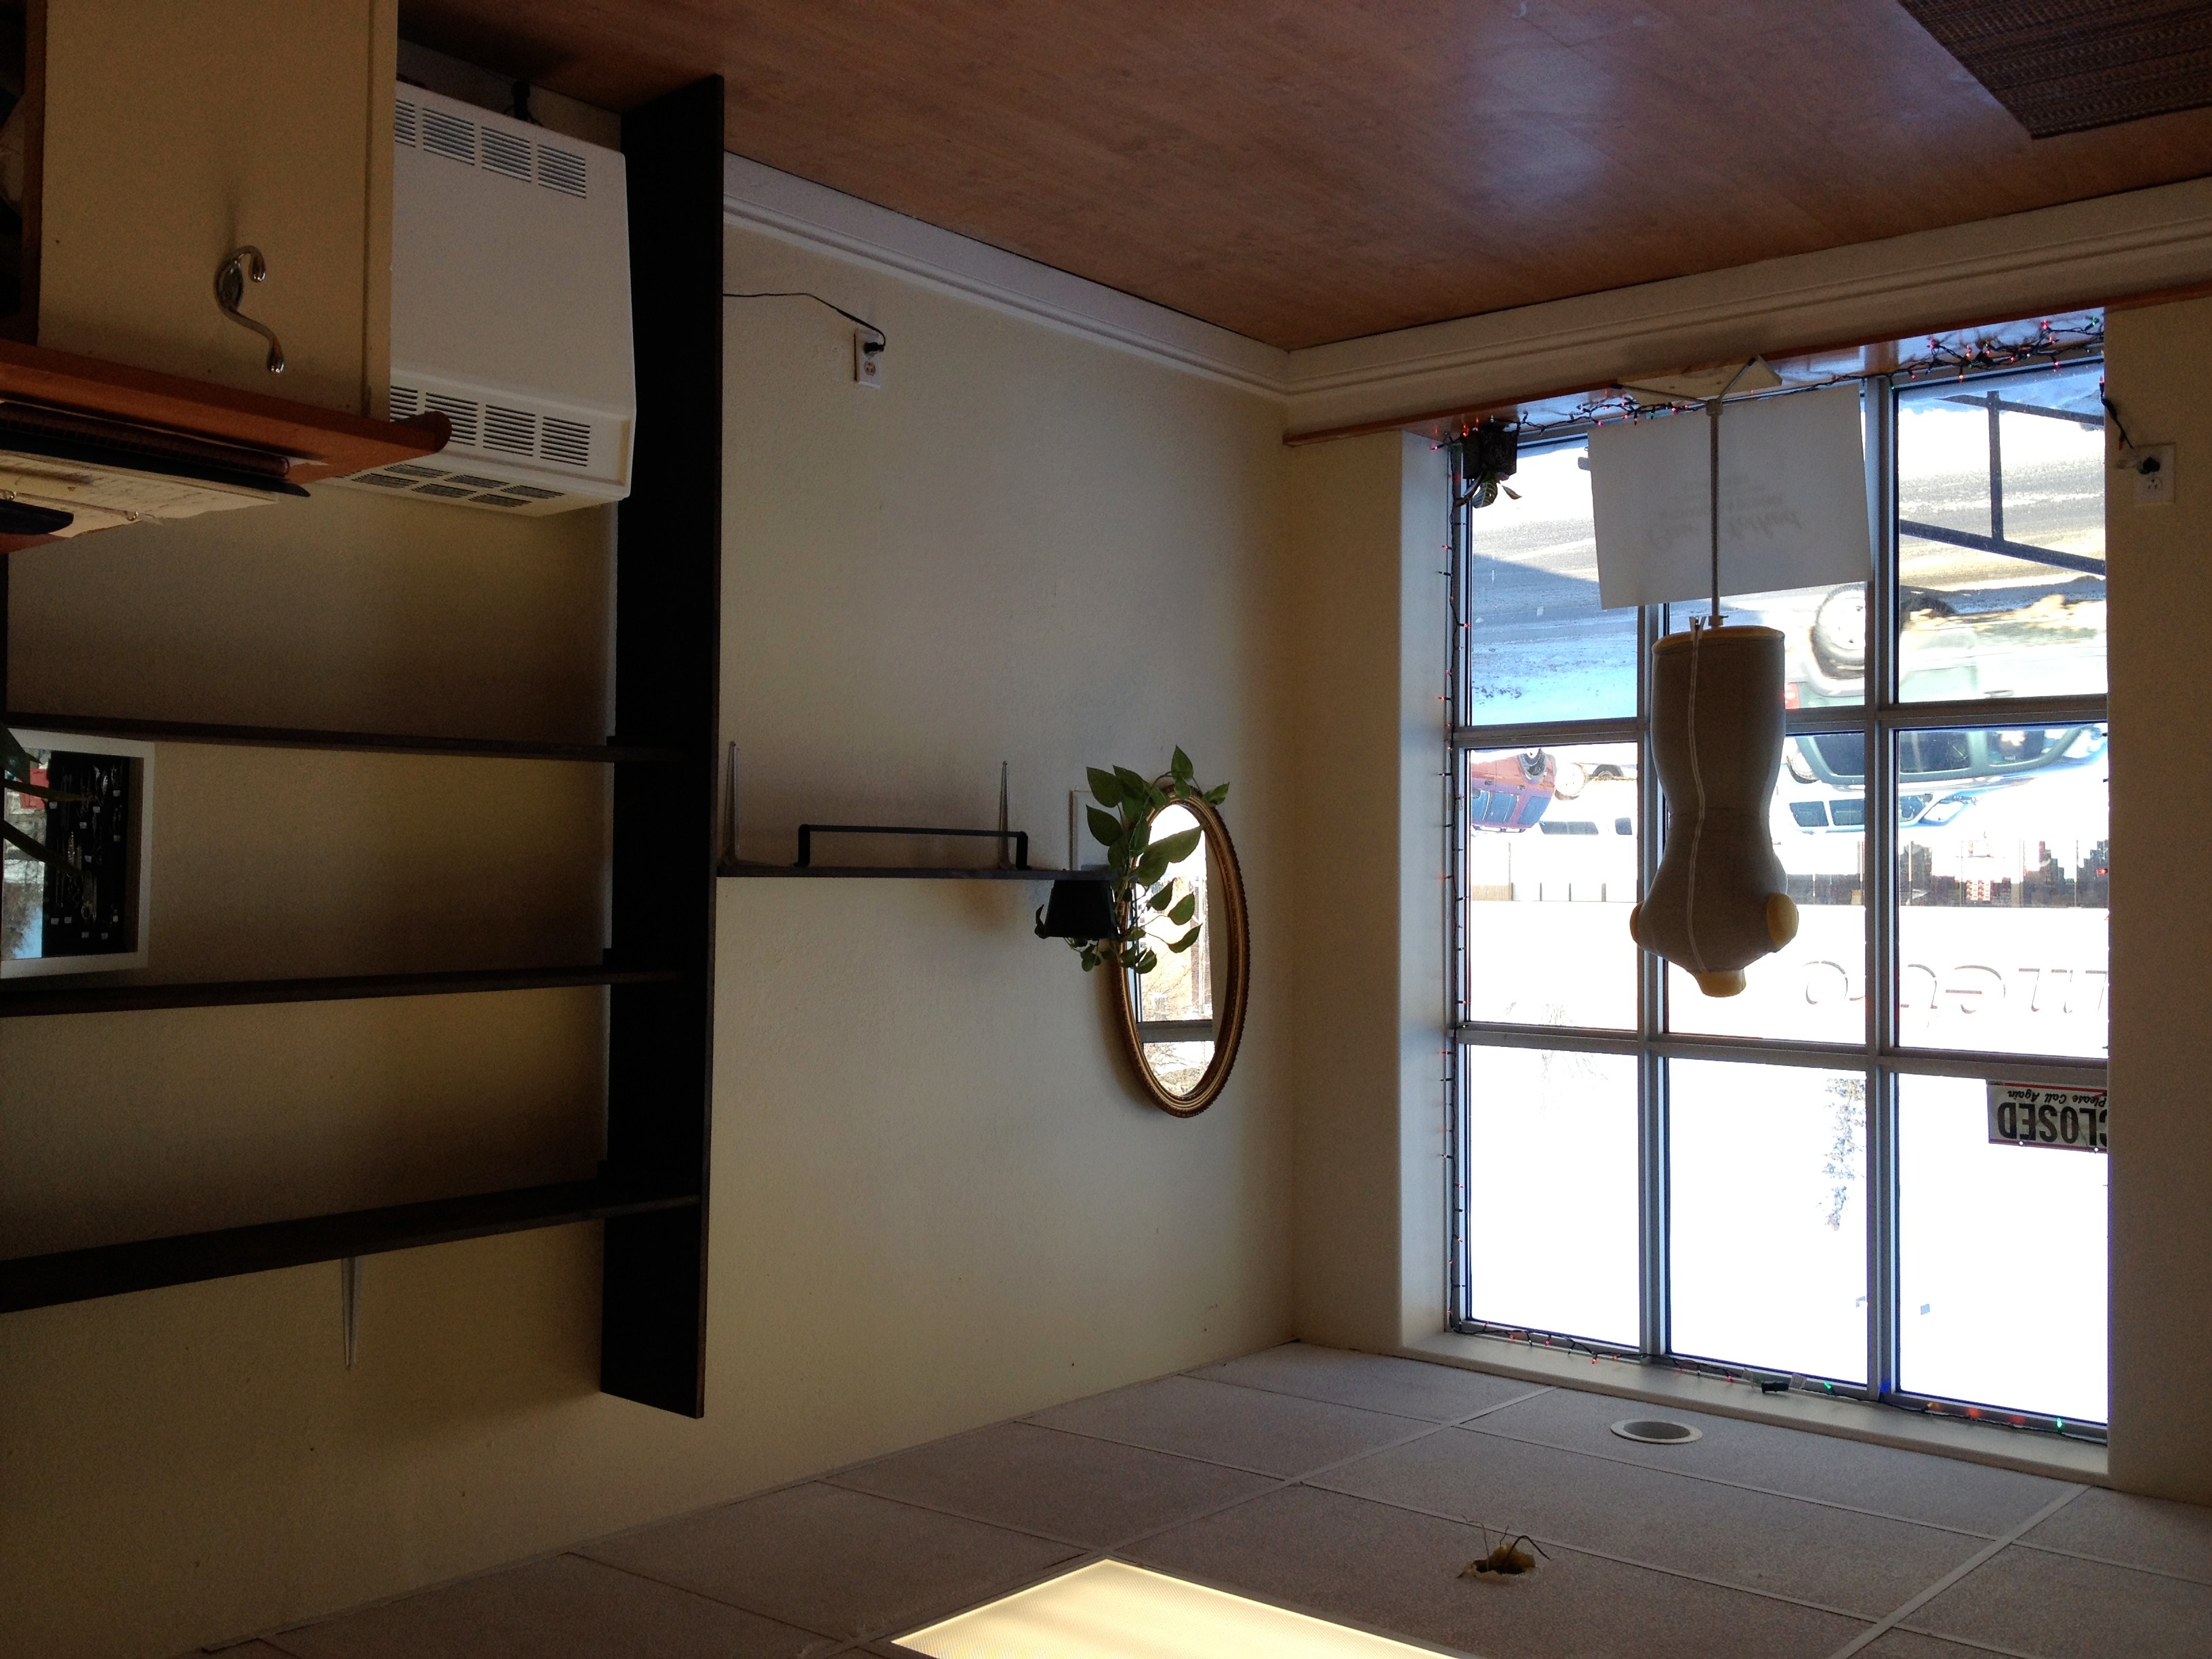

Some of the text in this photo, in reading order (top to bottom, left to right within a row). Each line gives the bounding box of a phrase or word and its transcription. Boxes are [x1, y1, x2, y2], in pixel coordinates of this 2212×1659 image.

[2007, 1089, 2107, 1107] Please Call Again
